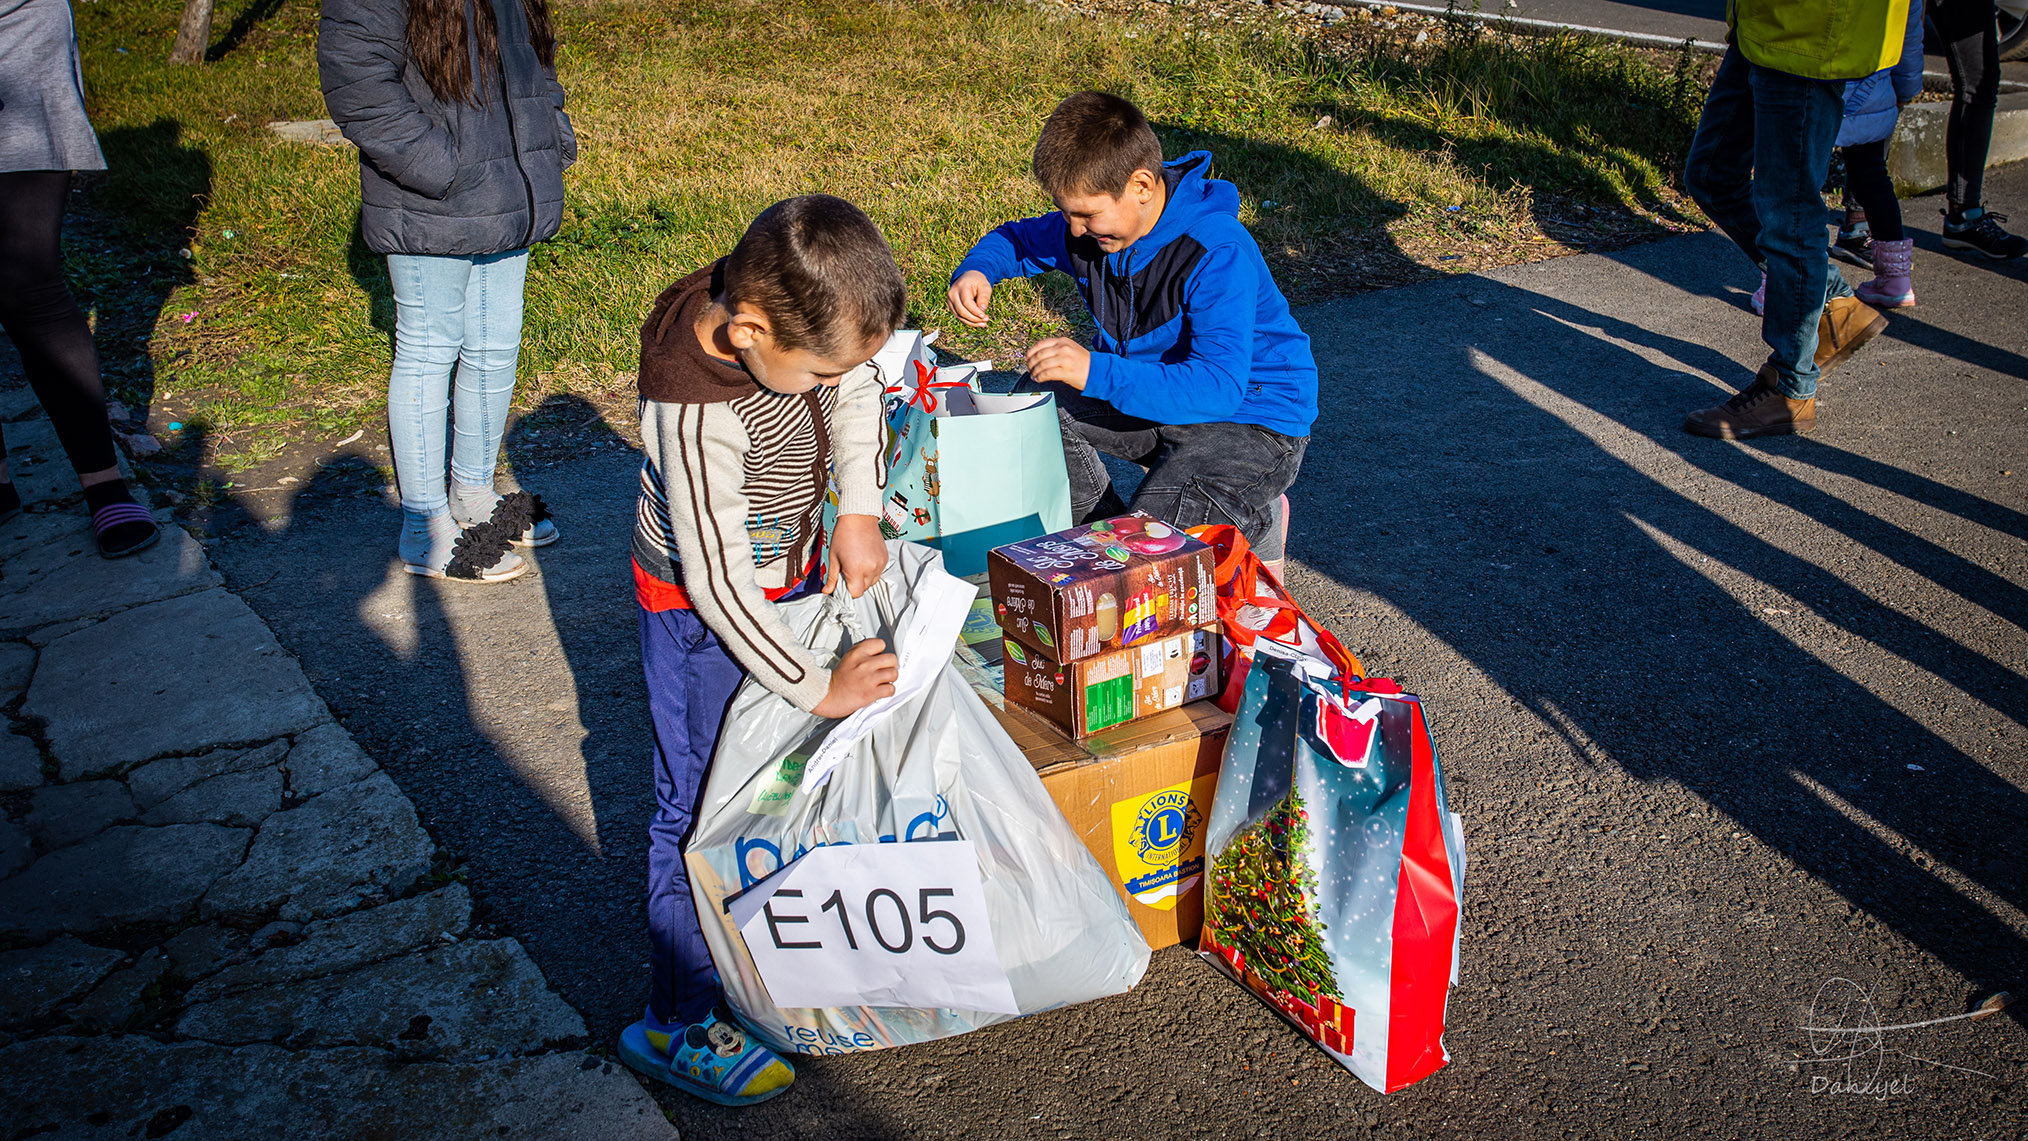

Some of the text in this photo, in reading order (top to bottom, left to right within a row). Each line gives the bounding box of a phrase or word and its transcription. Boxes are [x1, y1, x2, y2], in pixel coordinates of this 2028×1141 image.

[808, 737, 838, 774] Andrei-Daniel
[1144, 794, 1186, 816] LIONS
[1158, 814, 1177, 842] L
[1146, 842, 1188, 861] INTERNATIONAL
[1173, 863, 1198, 878] BASTION
[762, 887, 966, 955] E105
[784, 1025, 875, 1048] reuse
